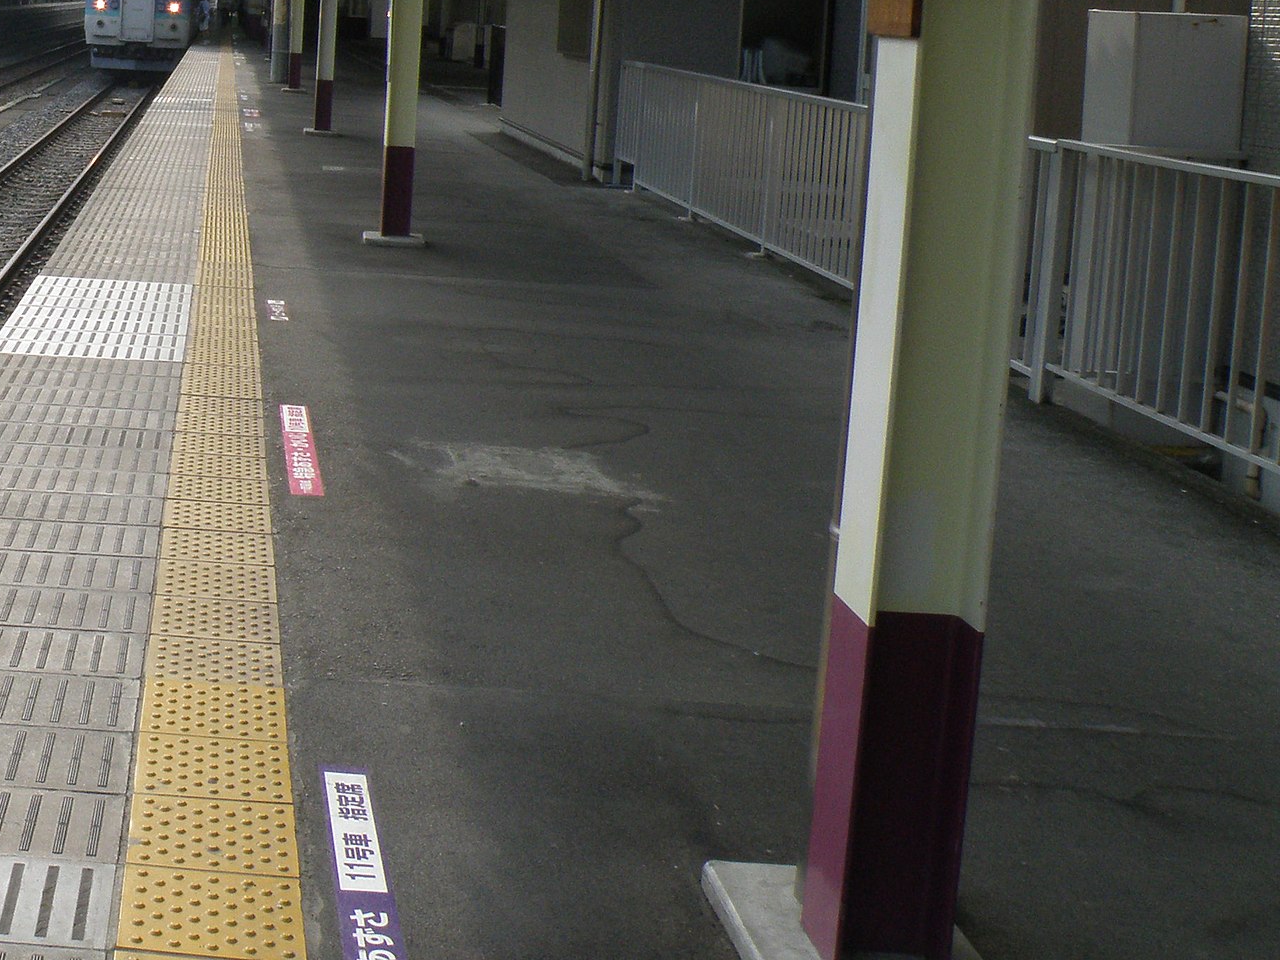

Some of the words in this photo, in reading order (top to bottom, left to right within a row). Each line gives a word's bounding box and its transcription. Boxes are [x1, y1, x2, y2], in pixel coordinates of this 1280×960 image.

[334, 782, 369, 821] 指定席
[342, 832, 376, 880] 11号車
